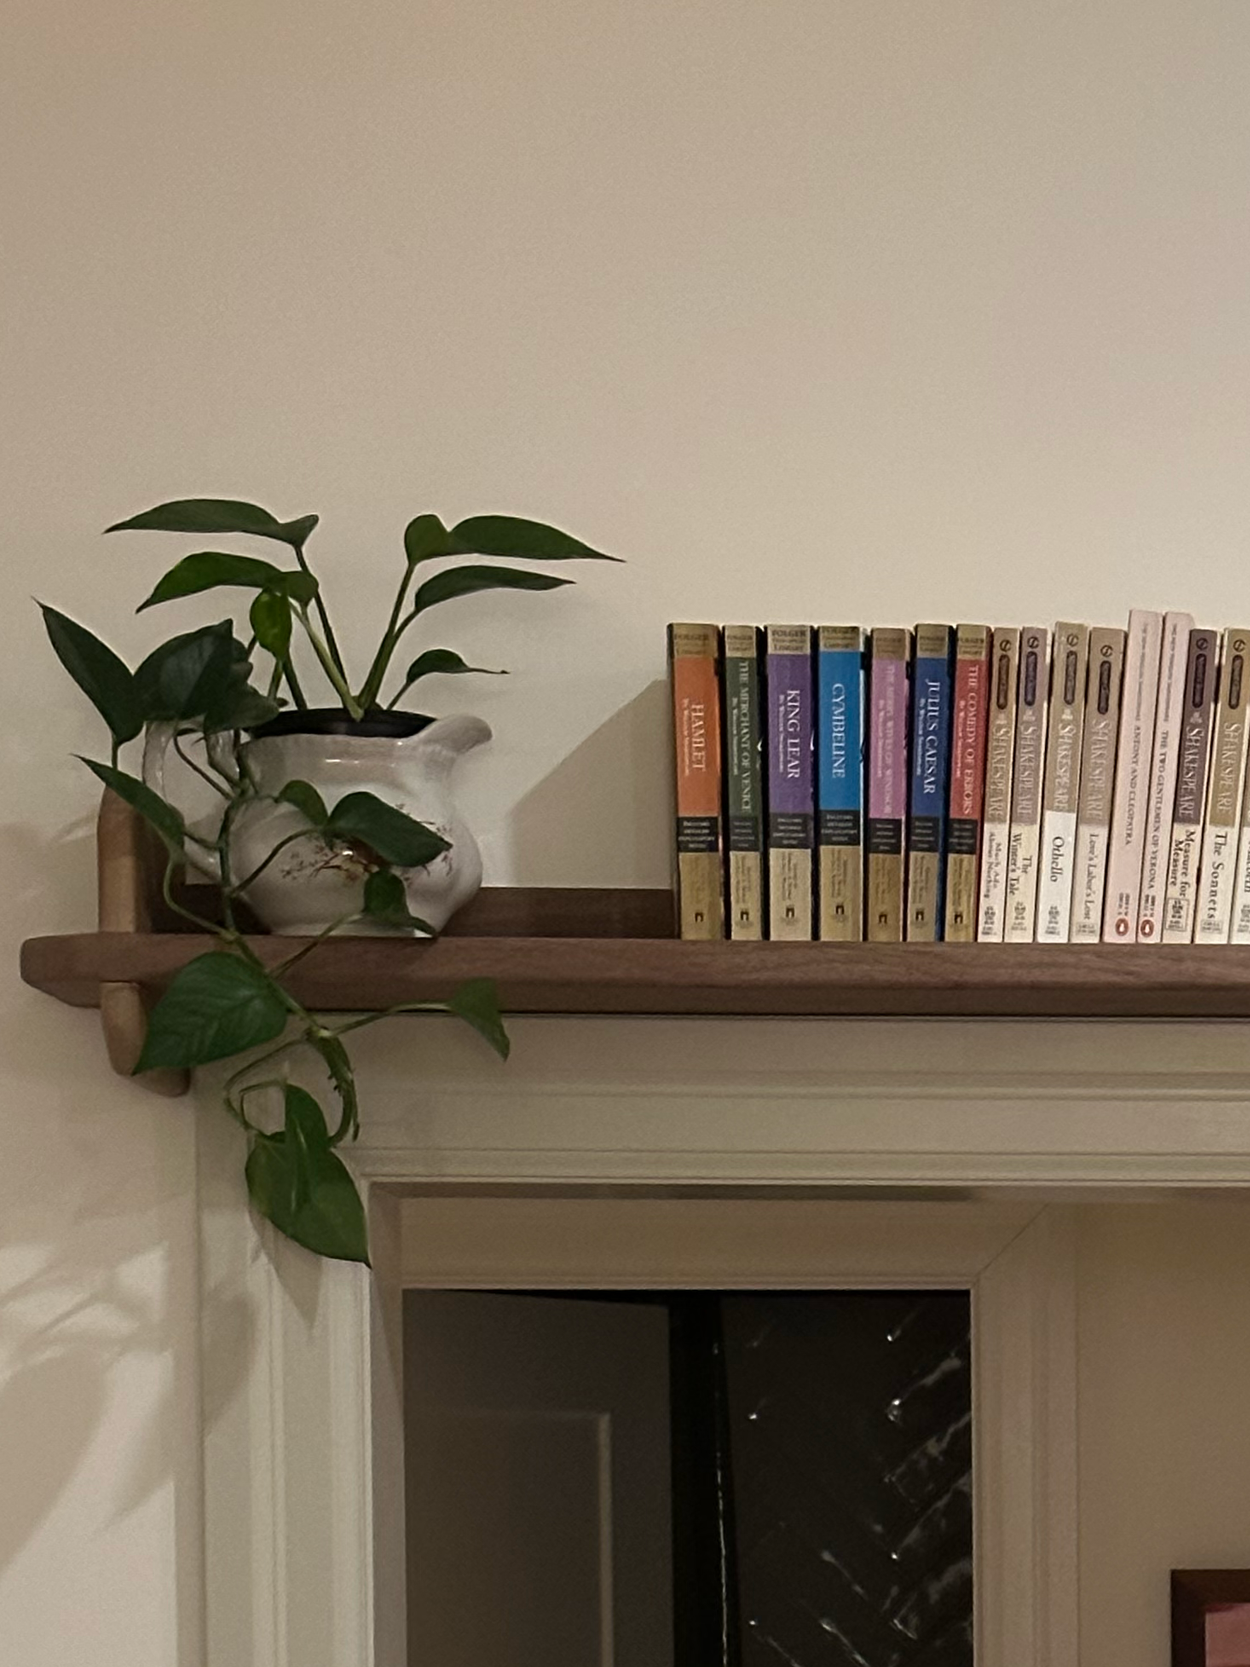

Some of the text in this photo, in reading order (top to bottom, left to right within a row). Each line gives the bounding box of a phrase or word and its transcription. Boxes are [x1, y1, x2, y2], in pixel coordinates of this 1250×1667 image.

[739, 661, 751, 684] THE
[691, 703, 706, 773] HAMLET
[739, 685, 751, 749] MERCHANT
[787, 689, 801, 780] KING LEAR
[831, 682, 846, 779] CYMBELINE
[924, 679, 940, 794] JULIUS CAESAR
[963, 665, 980, 814] THE COMEDY OF ERRORS
[1160, 731, 1169, 749] THE
[740, 751, 752, 770] OF
[740, 773, 753, 813] VENICE
[989, 727, 1010, 819] SHAKESPEARE
[1017, 726, 1040, 816] SHAKESPEARE
[1054, 724, 1077, 811] SHAKESPEARE
[1089, 720, 1110, 820] SHAKESPEARE
[1125, 725, 1141, 846] ANTONY AND CLEOPATRA
[1158, 751, 1167, 773] TWO
[1177, 725, 1205, 819] SHAKESPEARE
[1217, 722, 1242, 812] SHAKESPEARE
[1152, 774, 1165, 835] GENTLEMEN
[1009, 832, 1022, 896] Winter's Tale
[1022, 854, 1032, 874] The
[1050, 836, 1065, 882] Othello
[1147, 848, 1158, 890] VERONA
[1151, 834, 1159, 848] OF
[1170, 839, 1184, 887] Measure
[1179, 830, 1196, 898] Measure for
[1207, 831, 1228, 920] The Sonnets
[1084, 833, 1099, 921] Love's Labor's Lost
